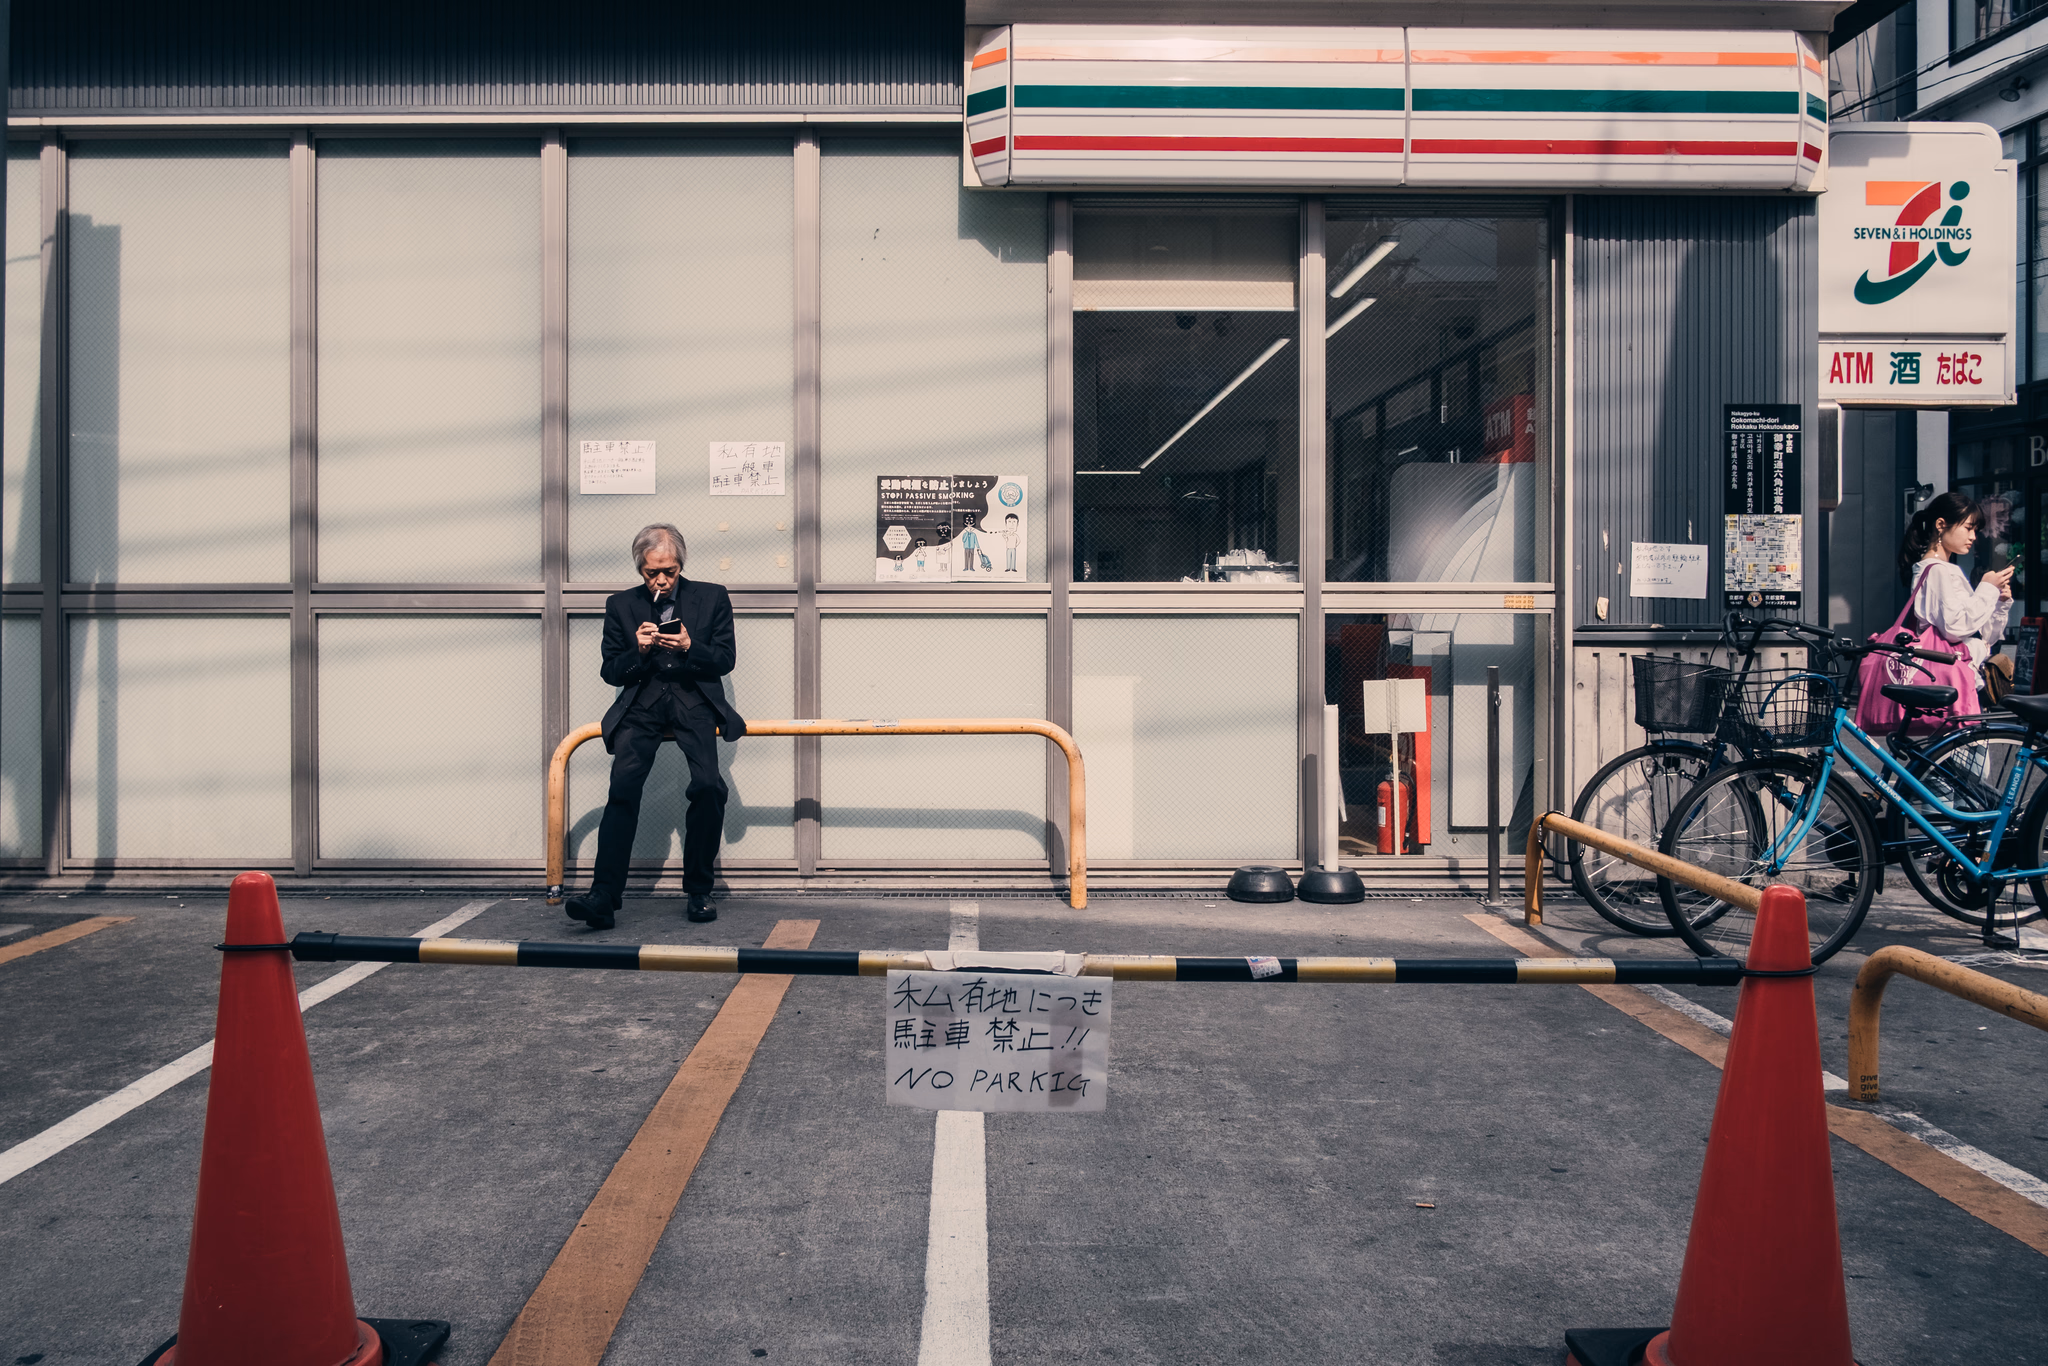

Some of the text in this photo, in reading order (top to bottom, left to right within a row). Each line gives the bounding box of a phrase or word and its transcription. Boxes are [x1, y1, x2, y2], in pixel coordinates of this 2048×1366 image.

[1909, 228, 1972, 240] HOLDINGS
[1829, 352, 1873, 384] ATM
[1889, 352, 1922, 385] 酒
[1936, 351, 1983, 385] たばこ
[1486, 409, 1511, 441] ATM
[718, 443, 781, 459] 私有地
[1786, 433, 1794, 454] 中京区
[712, 472, 780, 488] 駐車禁止
[721, 460, 774, 472] 一般車
[1773, 433, 1784, 514] 御幸町通六角北東角
[894, 974, 1102, 1016] 私有地につき
[894, 1067, 1091, 1097] NO PARKIG
